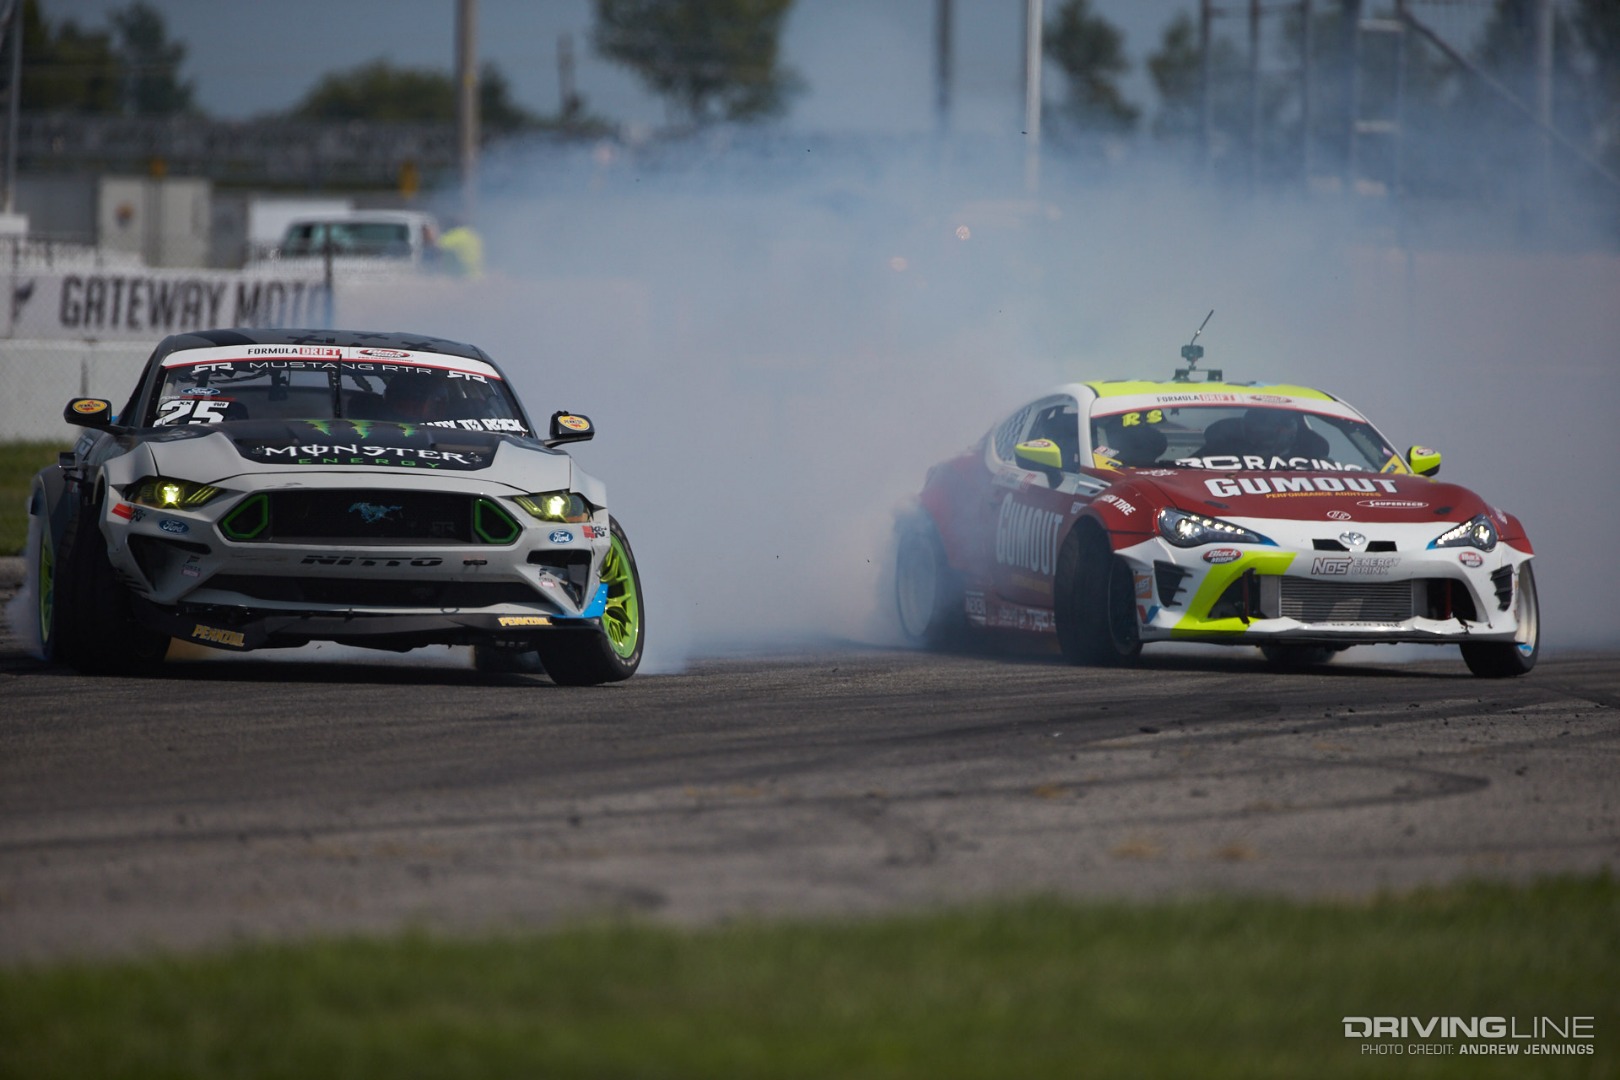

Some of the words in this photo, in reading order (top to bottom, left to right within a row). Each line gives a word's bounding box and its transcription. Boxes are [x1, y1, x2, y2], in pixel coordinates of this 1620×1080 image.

[59, 275, 228, 331] GATEWAY
[301, 348, 341, 356] DRIFT
[249, 362, 374, 371] MUSTANG
[382, 365, 432, 375] RTR
[152, 400, 229, 428] 25
[1122, 412, 1140, 427] R
[1146, 410, 1163, 423] S
[265, 444, 470, 465] MONSTER
[298, 457, 440, 469] ENERGY
[1204, 477, 1398, 498] GUMOUT
[1265, 491, 1332, 500] PERFORMANCE
[1112, 497, 1137, 516] TIRE
[162, 520, 185, 532] Ford
[552, 530, 570, 543] Ford
[996, 492, 1064, 577] GUMOUT
[301, 555, 443, 566] NITTO
[1208, 550, 1237, 558] Black
[1311, 557, 1352, 576] NOS
[1353, 557, 1400, 567] ENERGY
[1352, 566, 1389, 575] DRINK
[498, 617, 552, 626] PENNZOIL
[192, 624, 245, 647] PENNZOIL
